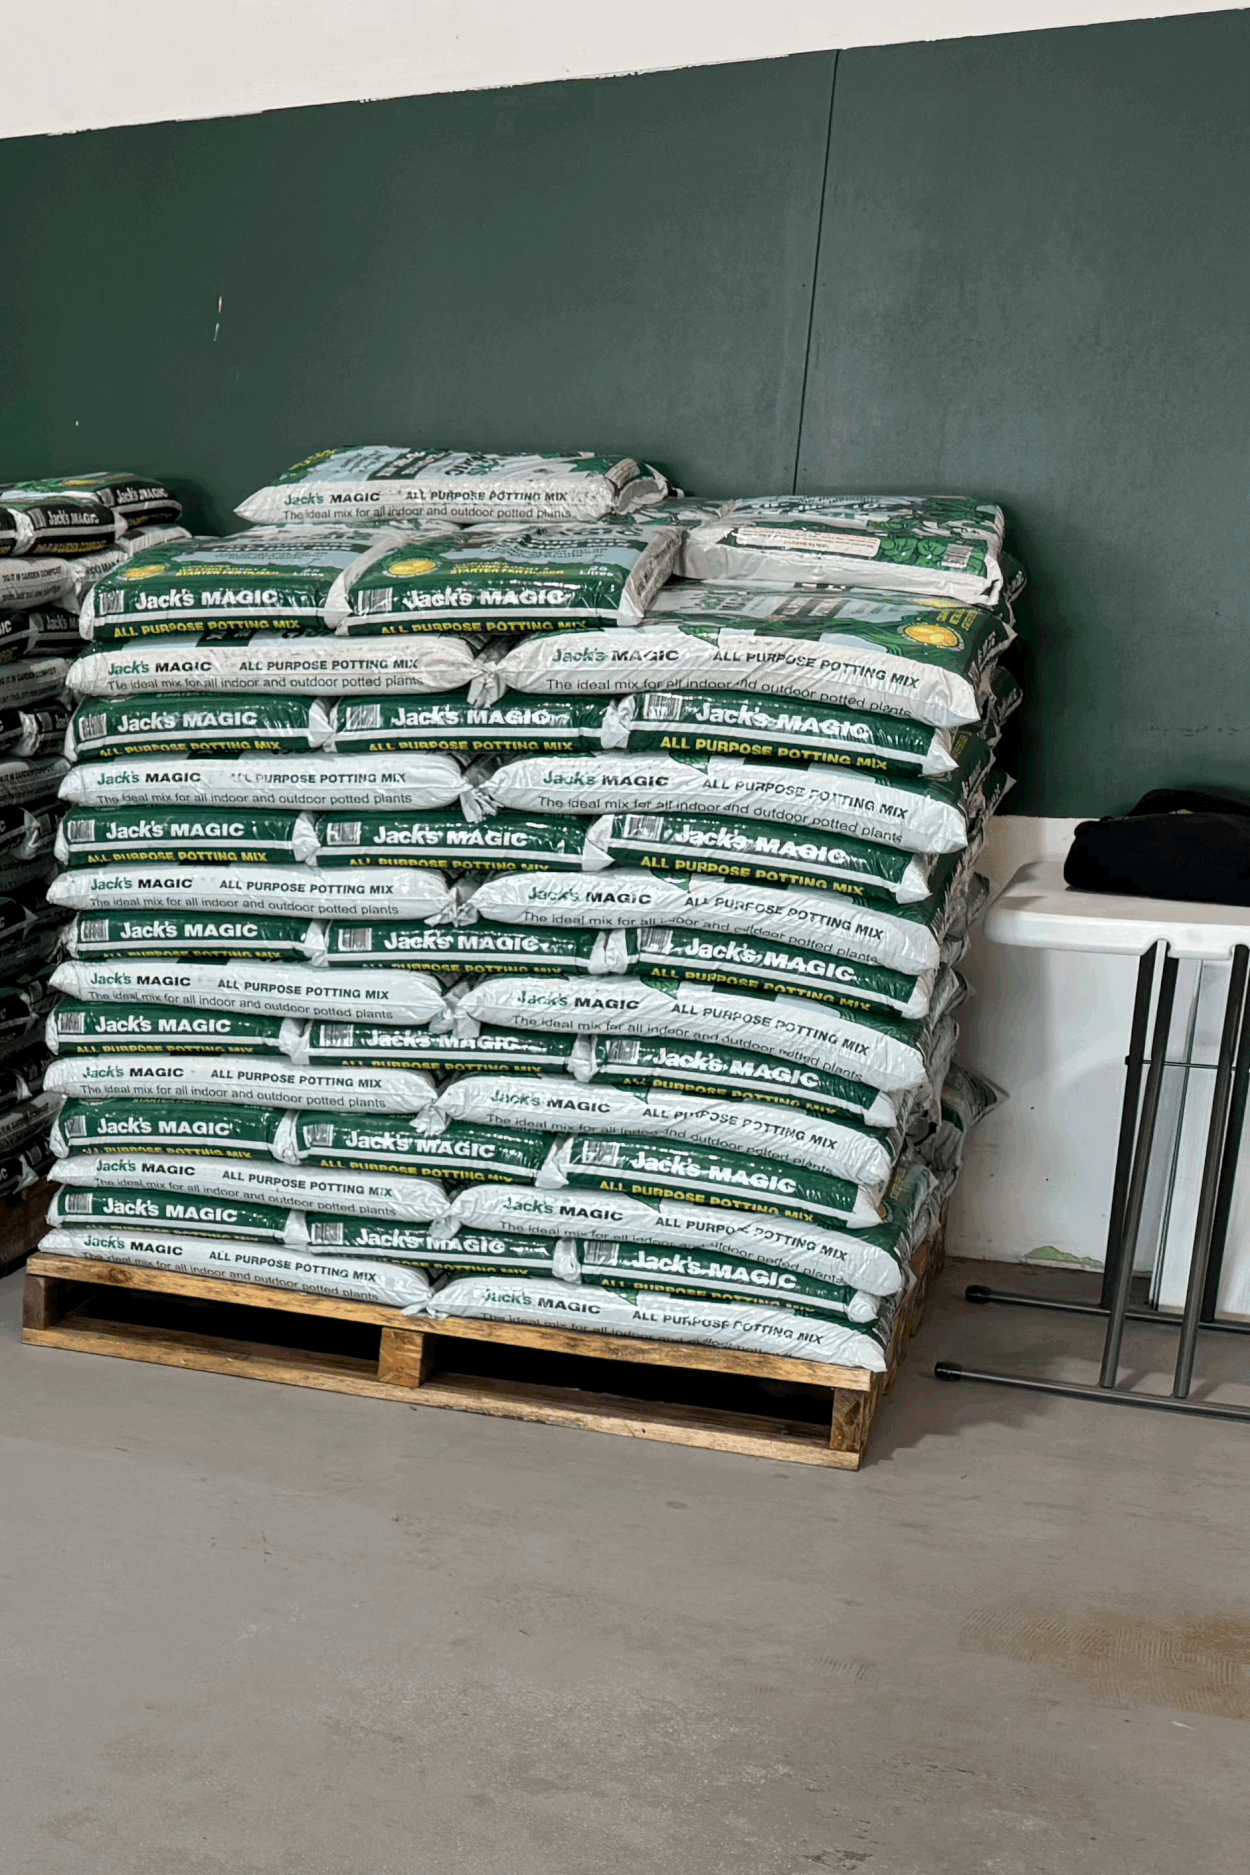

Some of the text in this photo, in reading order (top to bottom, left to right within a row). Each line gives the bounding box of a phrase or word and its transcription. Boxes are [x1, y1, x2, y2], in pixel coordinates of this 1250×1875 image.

[283, 492, 380, 506] Jack's MAGIC
[405, 490, 567, 502] ALL PURPOSE POTTING MIX
[282, 505, 571, 521] The ideal mix for all indoor and outdoor potted plants
[135, 590, 279, 610] Jack's MAGIC
[405, 587, 565, 610] Jack's MAGIC
[114, 619, 301, 638] ALL PURPOSE POTTING MIX
[381, 621, 587, 634] ALL PURPOSE POTTING MIX
[240, 659, 418, 670] ALL PURPOSE POTTING MIX
[552, 647, 680, 663] Jack's MAGIC
[108, 660, 212, 675] Jack's MAGIC
[713, 648, 920, 689] ALL PURPOSE POTTING MIX
[131, 679, 158, 689] ideal
[161, 679, 182, 688] mix
[185, 678, 200, 688] for
[204, 678, 218, 687] all
[221, 678, 260, 688] indoor
[264, 678, 286, 687] and
[290, 677, 338, 687] outdoor
[341, 676, 382, 688] potted
[385, 675, 423, 687] plants
[696, 702, 870, 740] Jack's MAGIC
[105, 820, 245, 840] Jack's MAGIC
[120, 921, 258, 939] Jack's MAGIC
[95, 1014, 231, 1033] Jack's MAGIC
[632, 1151, 796, 1193] Jack's MAGIC
[103, 1197, 238, 1221] Jack's MAGIC
[83, 1234, 183, 1256] Jack's MAGIC
